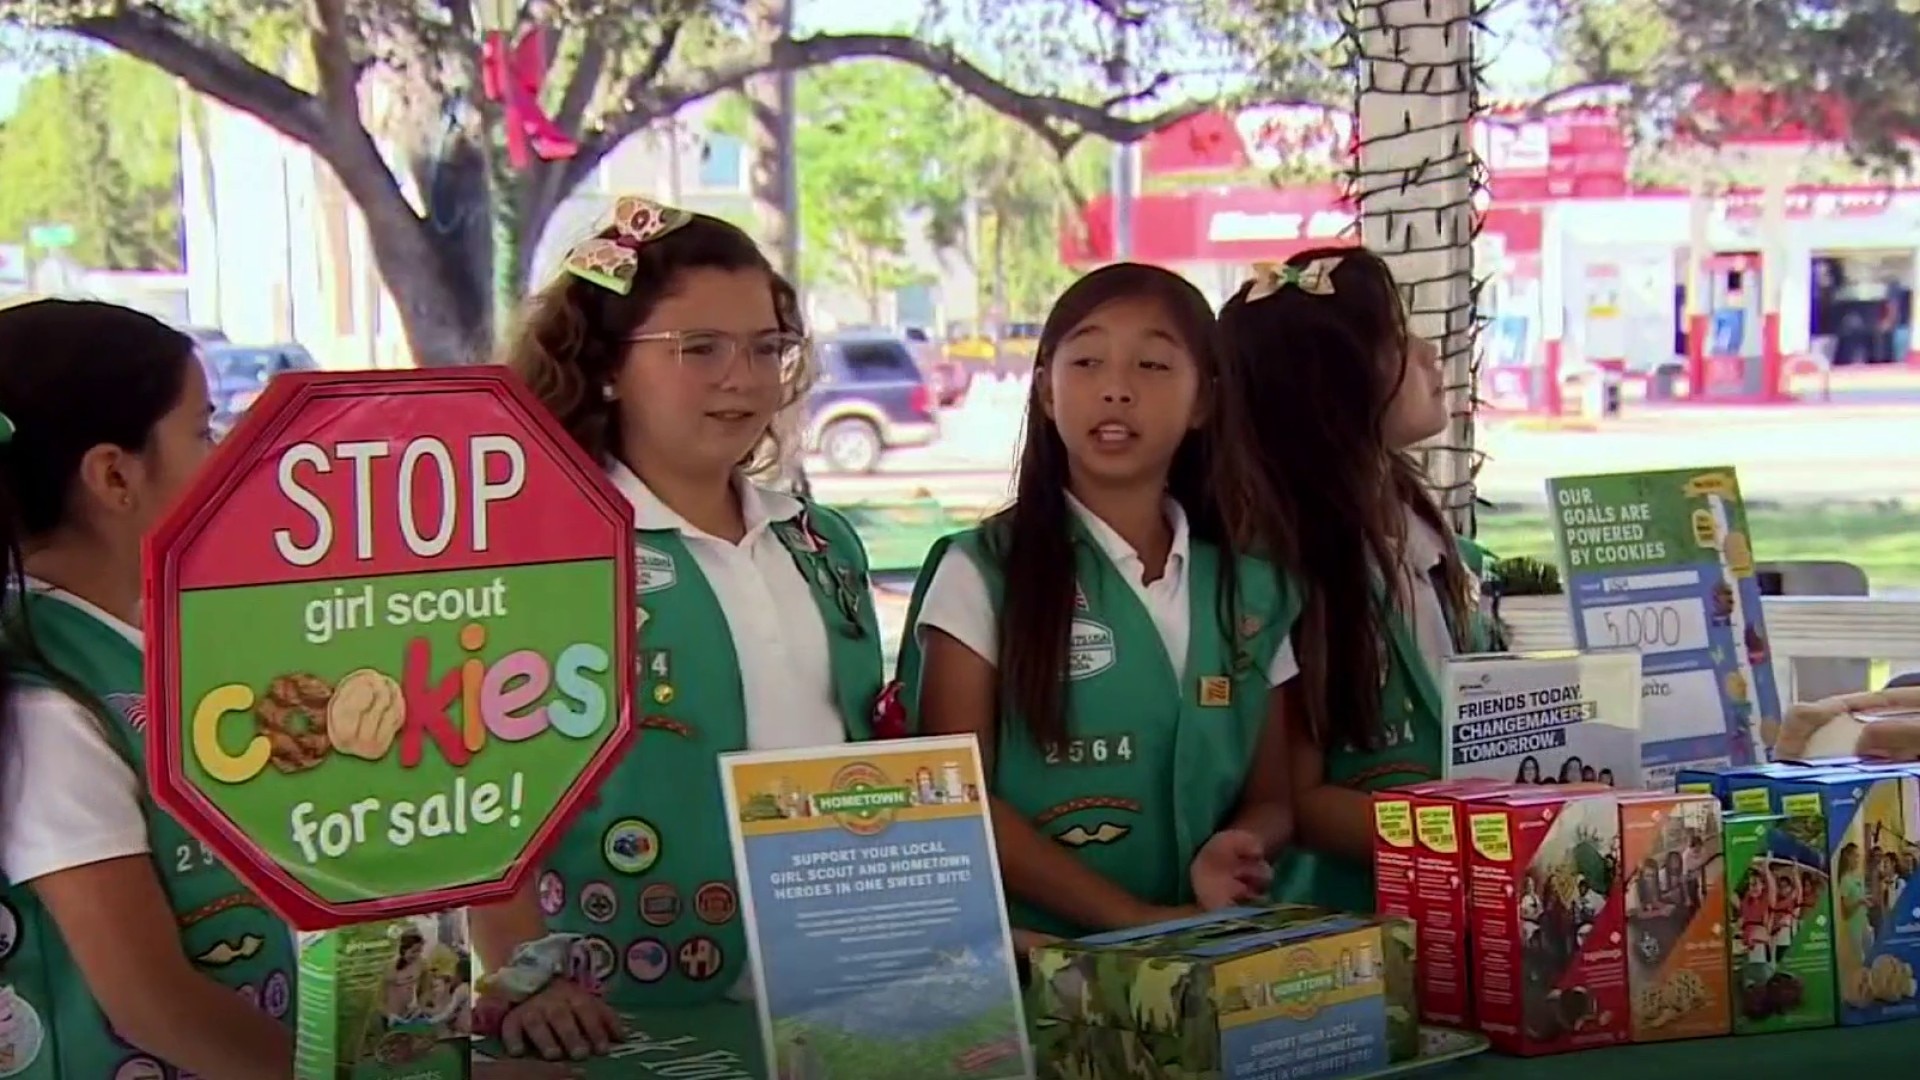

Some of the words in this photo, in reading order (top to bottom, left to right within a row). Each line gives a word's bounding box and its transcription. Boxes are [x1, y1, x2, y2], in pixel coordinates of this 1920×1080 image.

[273, 436, 526, 566] STOP
[1559, 487, 1592, 506] OUR
[1563, 505, 1616, 525] GOALS
[1621, 503, 1651, 521] ARE
[1567, 523, 1643, 546] POWERED
[1570, 547, 1590, 566] BY
[1595, 541, 1666, 563] COOKIES
[304, 584, 374, 644] girl
[386, 577, 508, 626] scout
[192, 623, 610, 783] cookies
[1458, 693, 1526, 719] FRIENDS
[1459, 703, 1591, 741] CHANGEMAKERS
[1460, 730, 1559, 762] TOMORROW.
[820, 790, 906, 811] HOMETOWN
[291, 797, 381, 863] for
[388, 772, 524, 846] sale!
[791, 848, 858, 867] SUPPORT
[861, 845, 899, 861] YOUR
[902, 841, 946, 856] LOCAL
[770, 871, 803, 885] GIRL
[807, 864, 855, 881] SCOUT
[858, 862, 888, 876] AND
[890, 854, 971, 872] HOMETOWN
[773, 882, 832, 899] HEROES
[836, 882, 851, 895] IN
[855, 878, 884, 892] ONE
[887, 873, 932, 889] SWEET
[936, 869, 972, 885] BITE!
